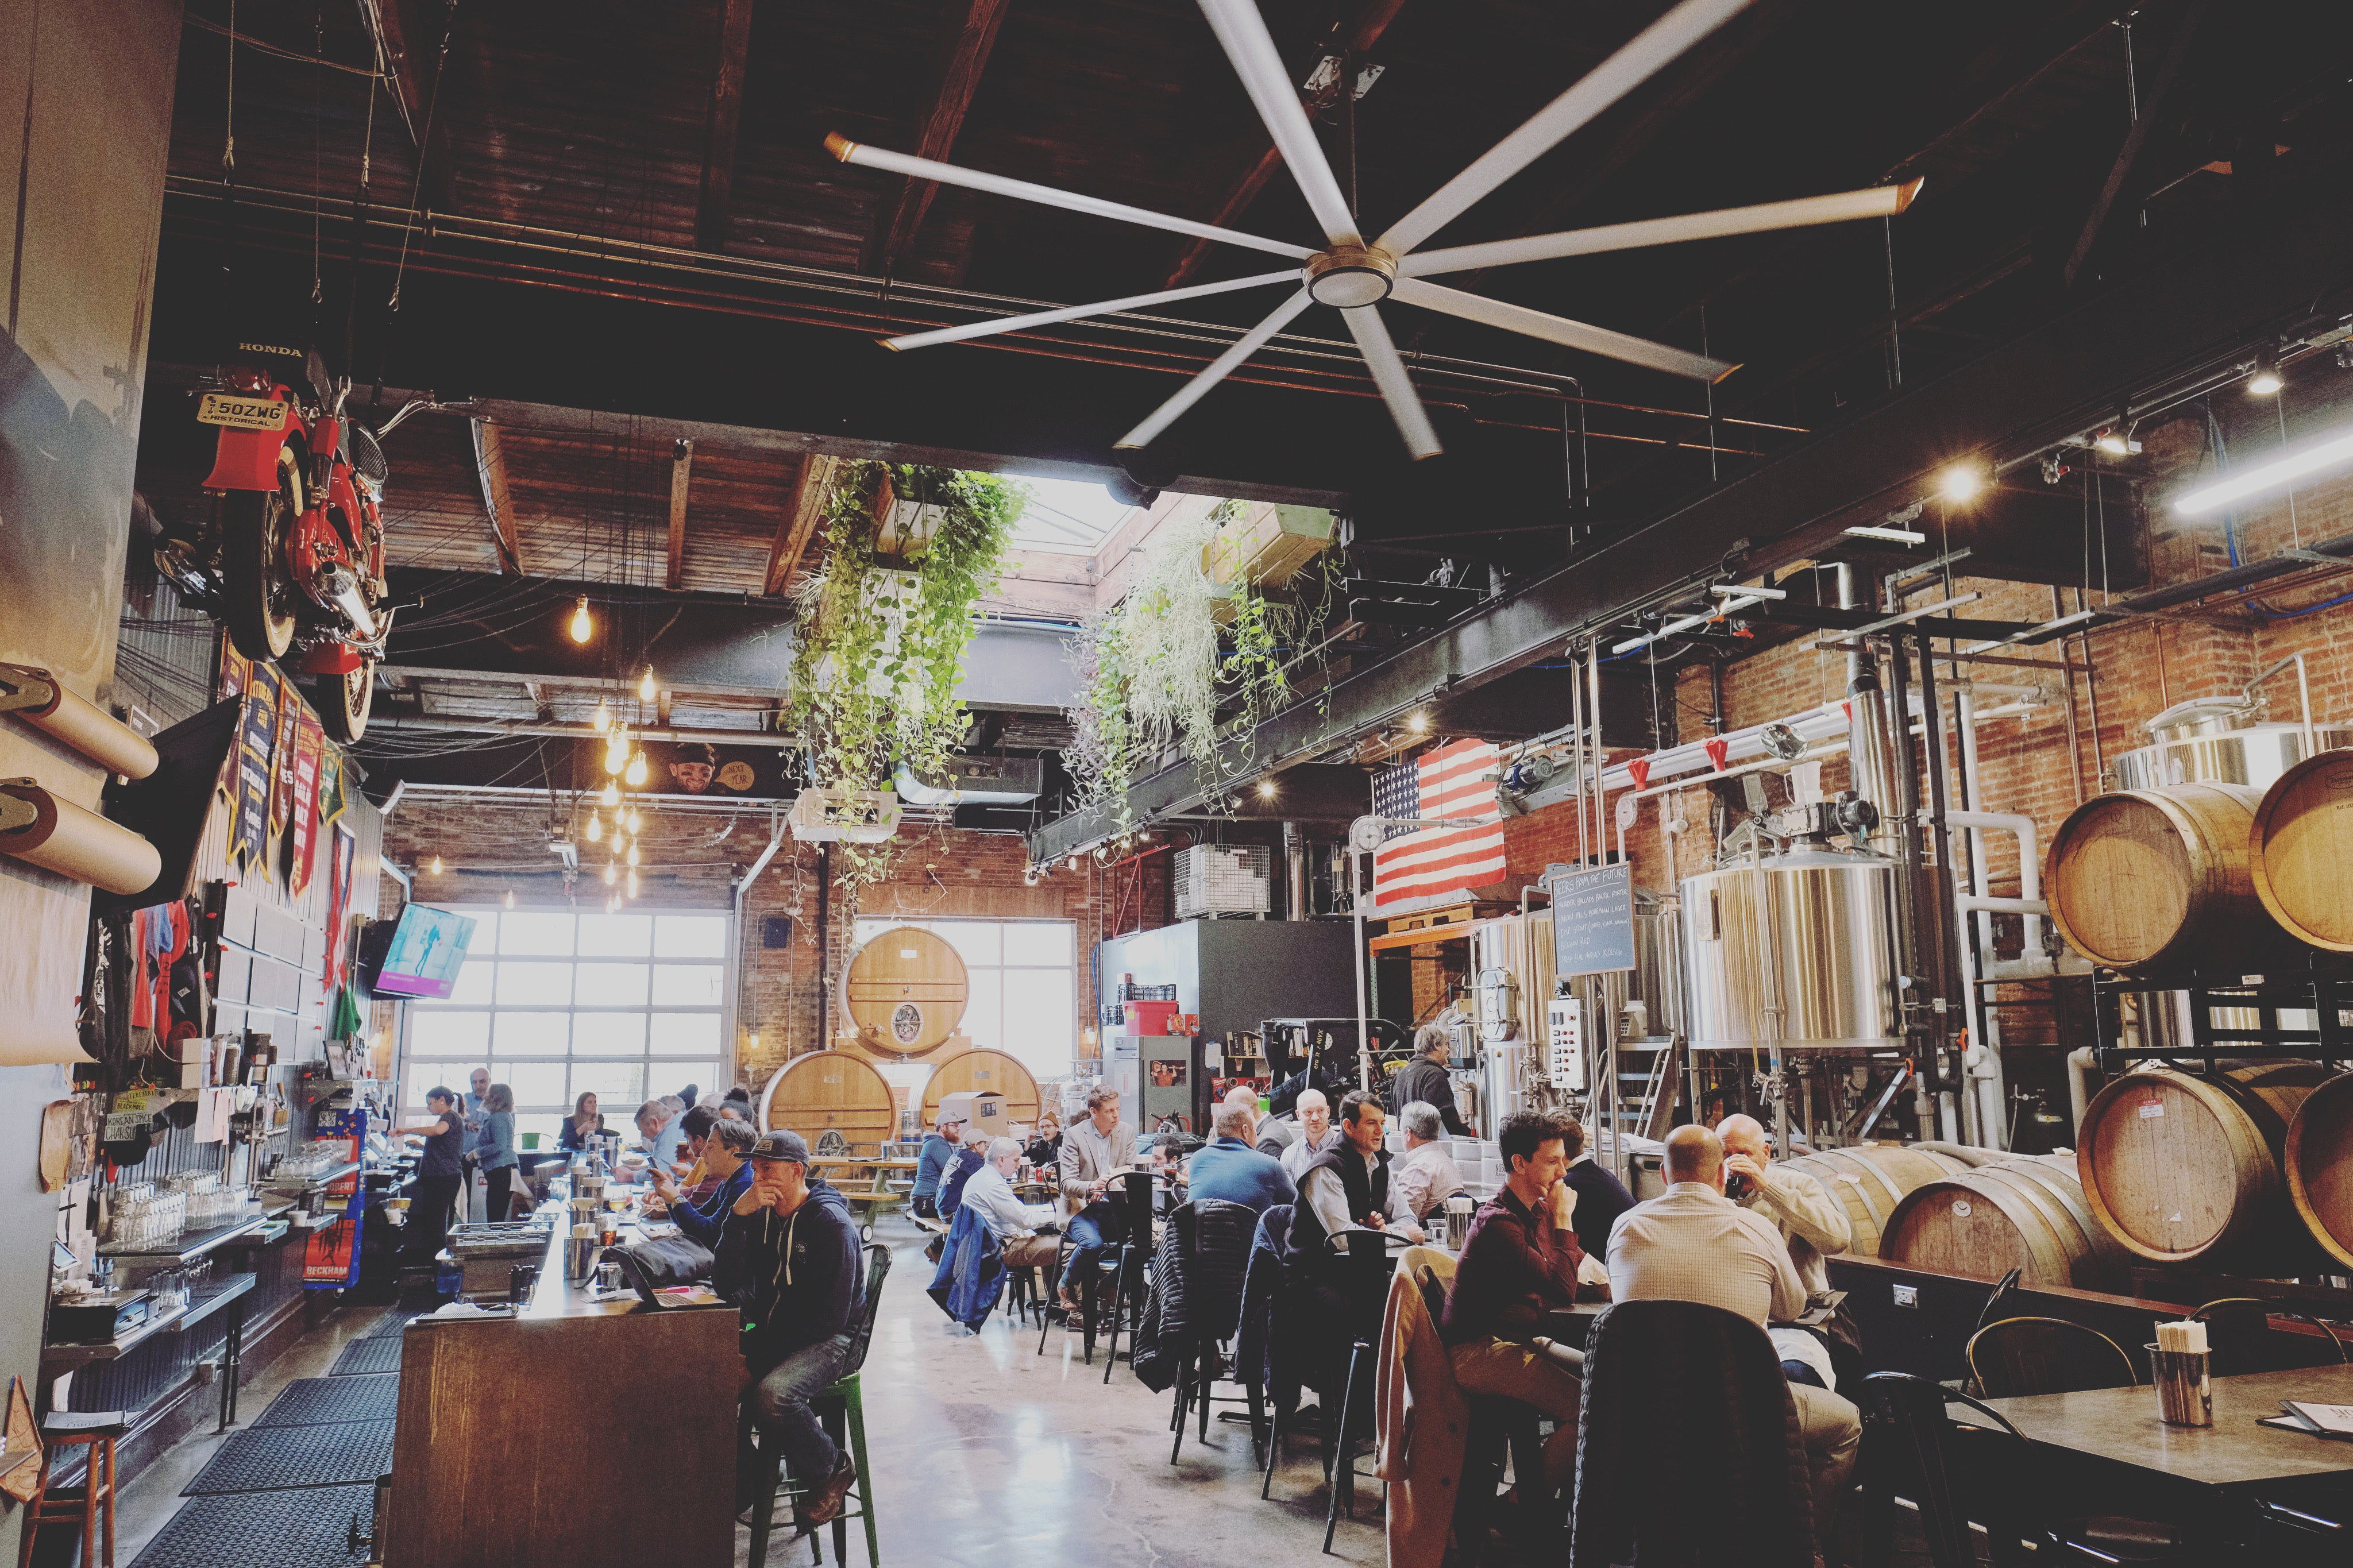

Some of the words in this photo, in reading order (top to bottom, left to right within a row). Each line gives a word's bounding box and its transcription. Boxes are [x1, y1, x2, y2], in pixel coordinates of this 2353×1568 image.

[239, 343, 303, 357] HONDA
[210, 415, 271, 426] HISTORICAL
[731, 775, 748, 784] YEAR
[1553, 880, 1574, 897] BEERS
[1576, 876, 1590, 889] FROM
[1590, 873, 1600, 883] THE
[1602, 867, 1627, 882] FUTURE
[1577, 896, 1594, 906] BALLADS
[1596, 893, 1610, 902] BALTIC
[1612, 889, 1628, 897] PORTER
[1559, 913, 1573, 924] UNION
[1576, 910, 1587, 919] PILS
[1588, 907, 1609, 917] BOHEMIAN
[1611, 905, 1626, 913] LAGER
[1573, 924, 1587, 933] STOUT
[1580, 937, 1590, 945] RED
[107, 1115, 134, 1126] KOREAN
[135, 1114, 151, 1123] SPICE
[307, 1266, 348, 1275] BECKHAM
